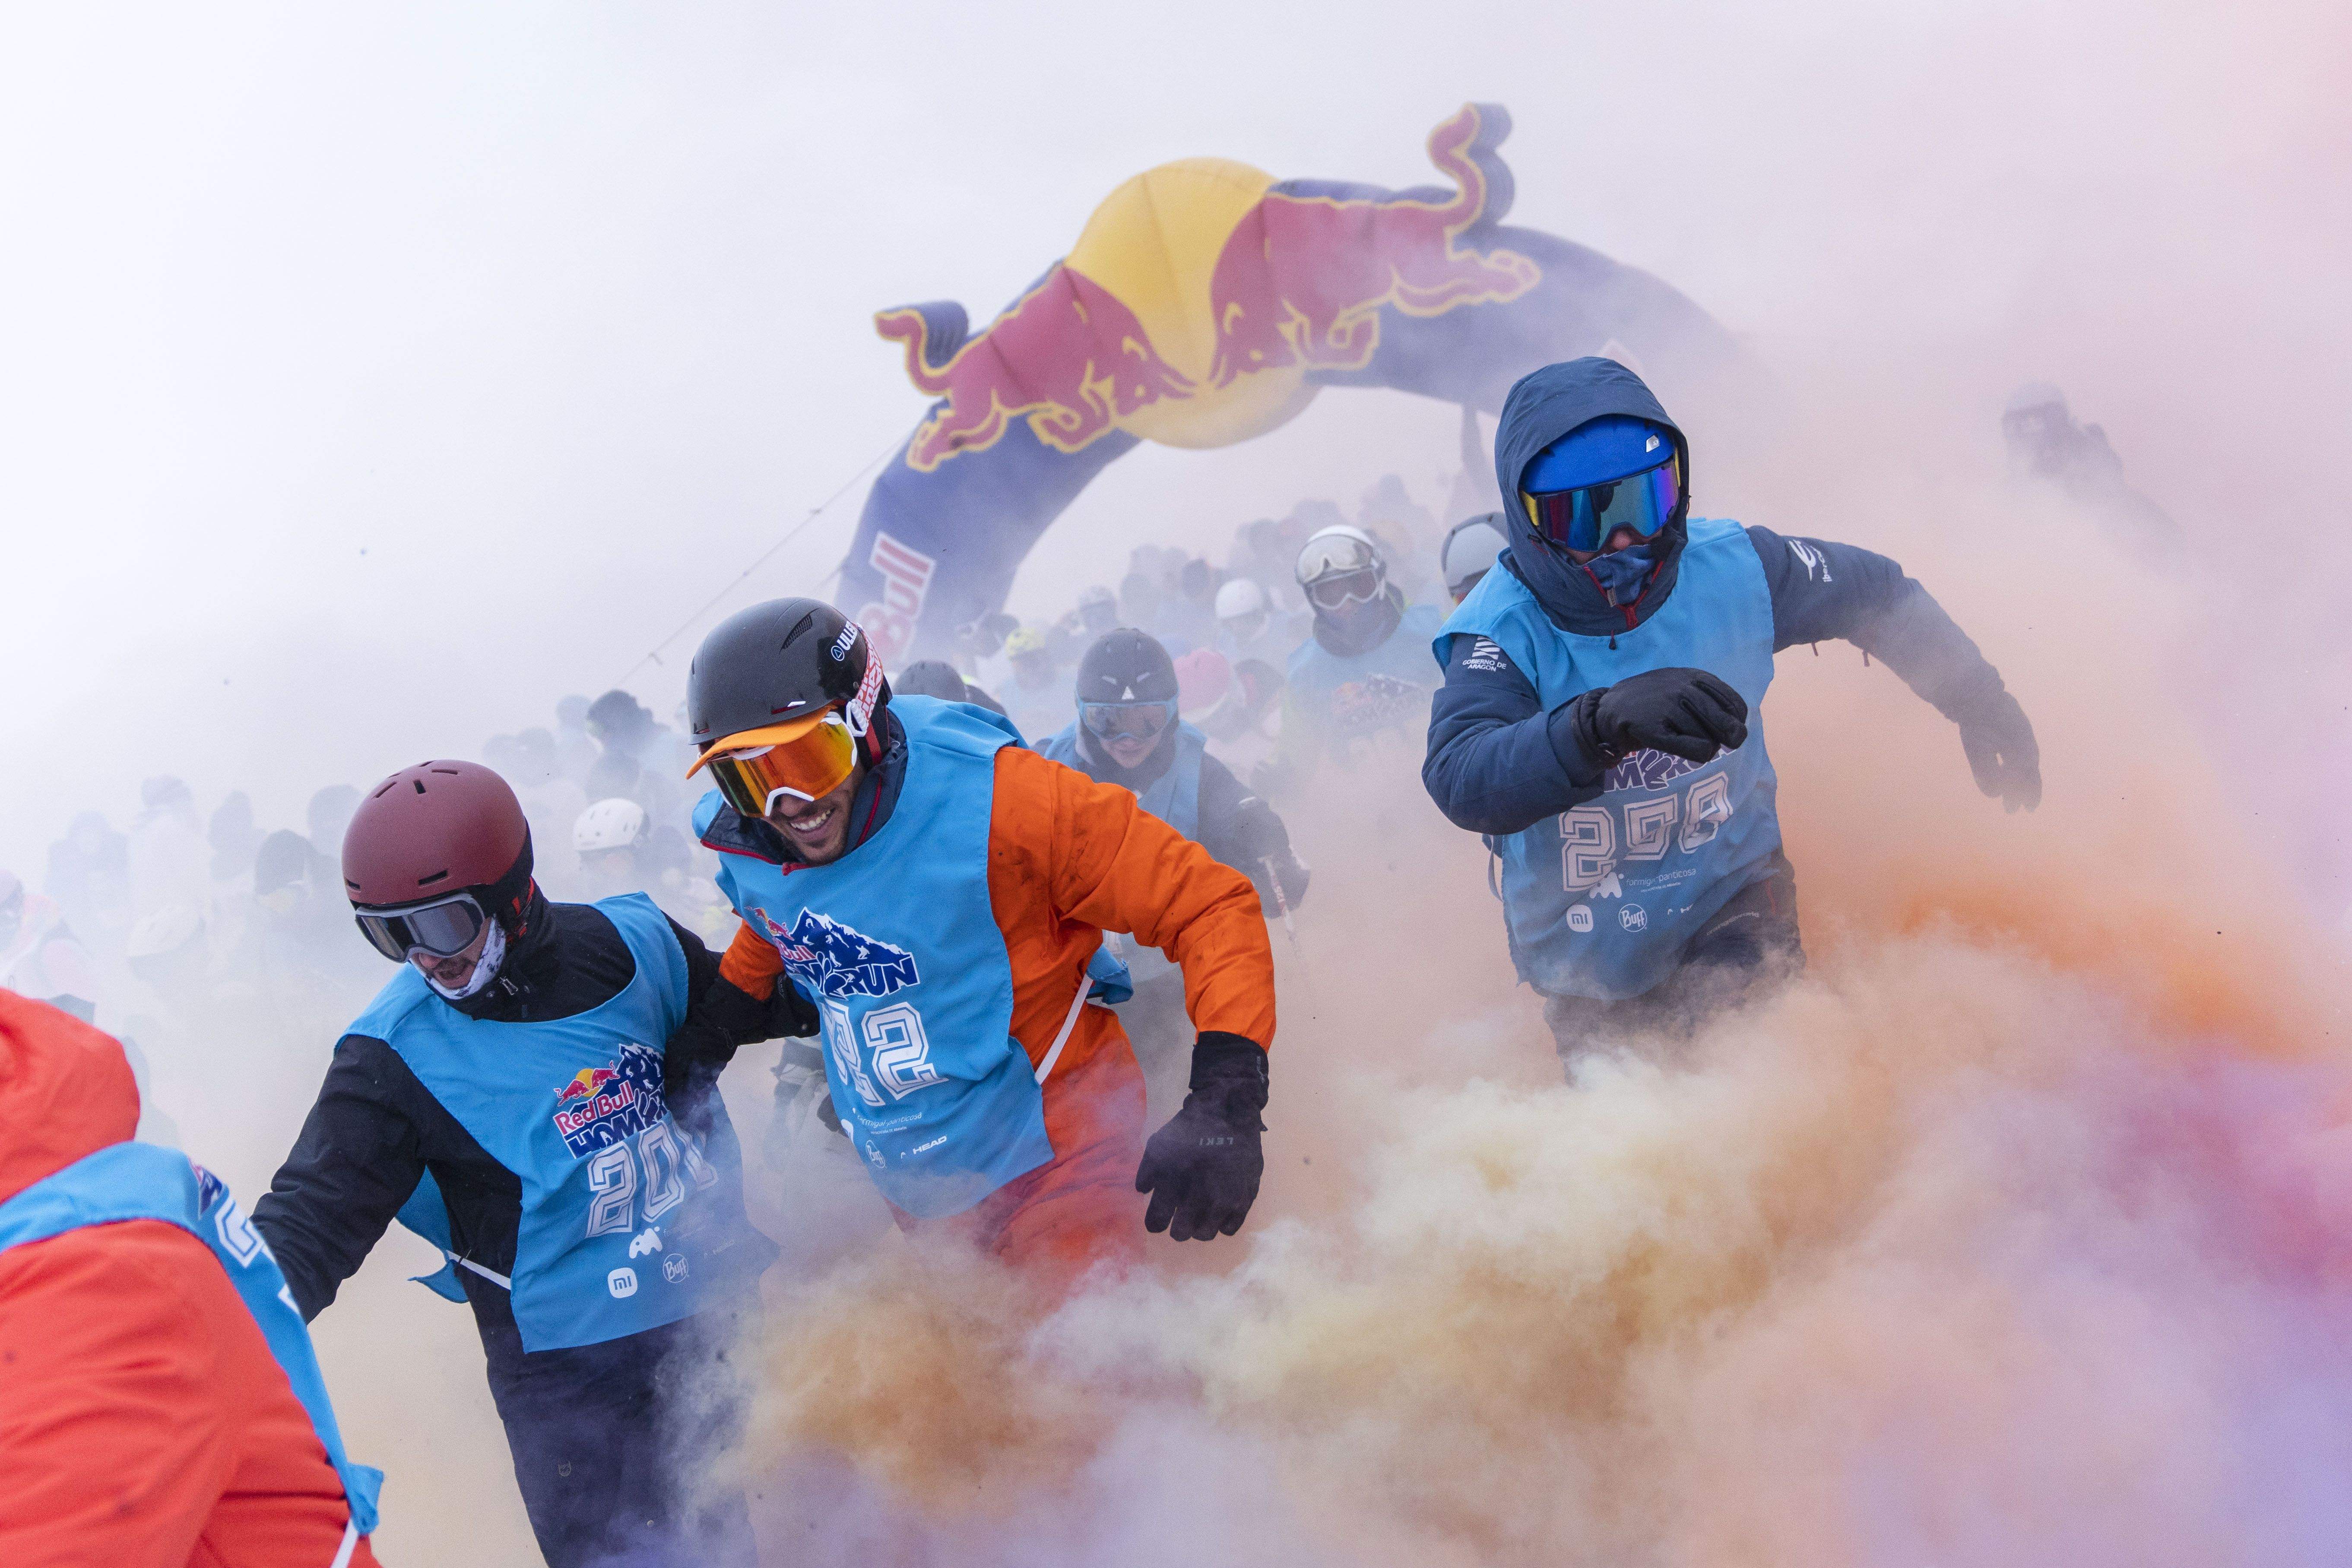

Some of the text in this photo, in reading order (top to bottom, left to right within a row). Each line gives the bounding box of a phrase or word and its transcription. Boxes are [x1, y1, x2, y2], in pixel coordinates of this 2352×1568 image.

[837, 621, 858, 650] ULLE
[553, 1080, 634, 1137] Red Bull
[913, 1135, 947, 1155] HEAD
